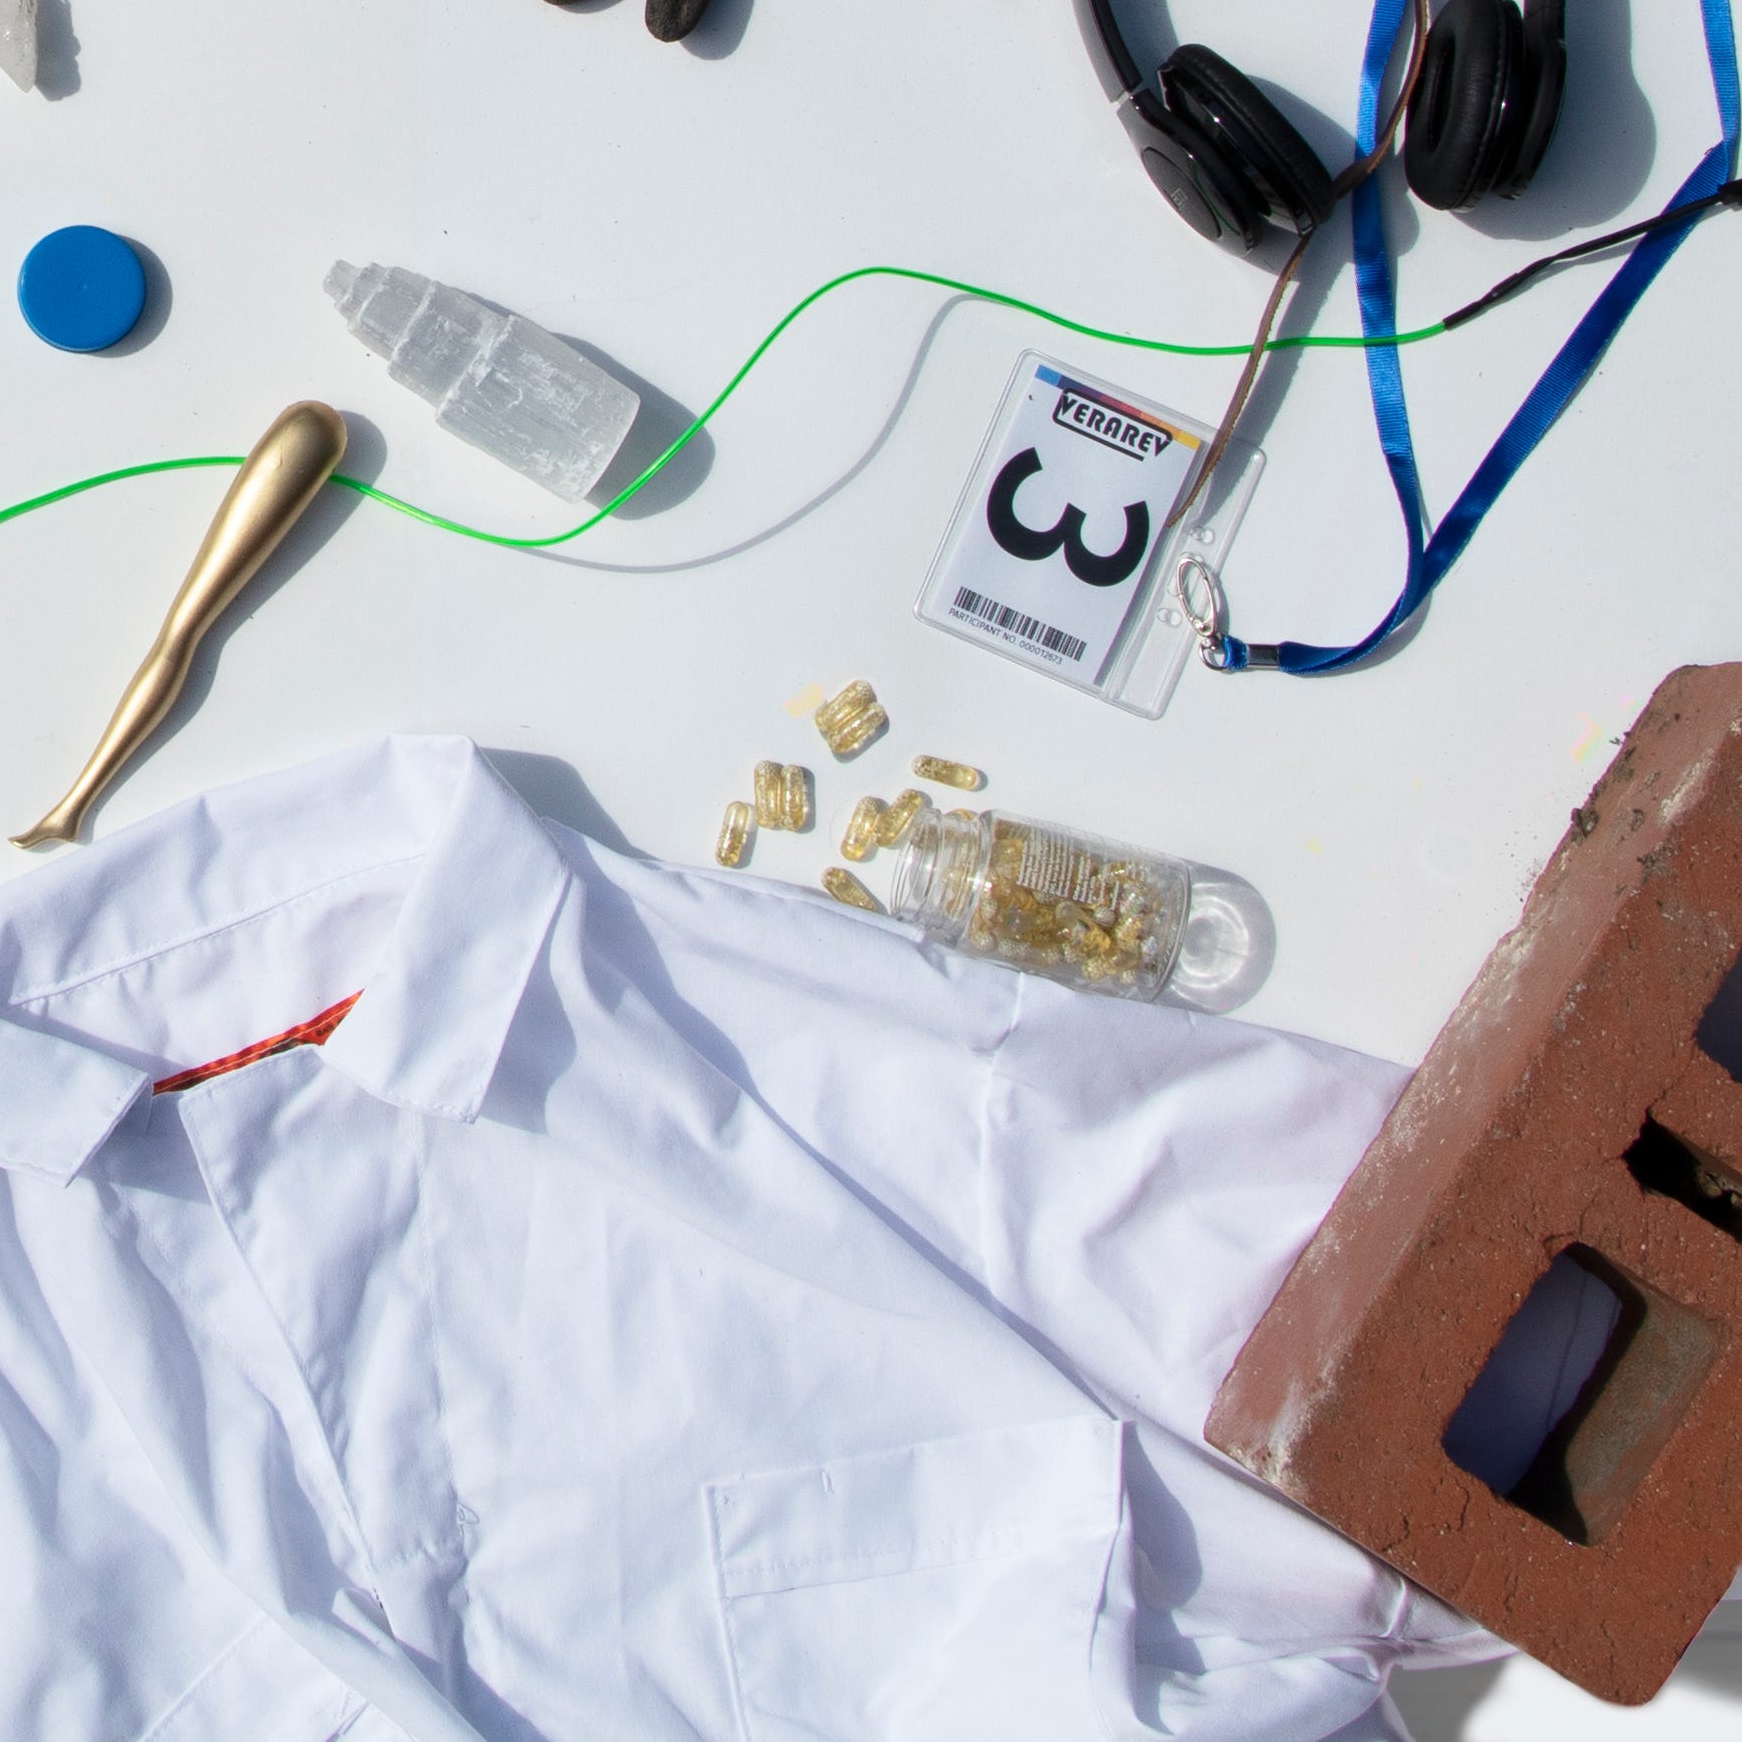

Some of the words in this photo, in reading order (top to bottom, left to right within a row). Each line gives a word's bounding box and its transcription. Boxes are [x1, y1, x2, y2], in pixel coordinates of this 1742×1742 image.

[1061, 394, 1172, 458] VERAREV
[986, 446, 1150, 587] 3
[947, 606, 1001, 637] PARTICIPANT
